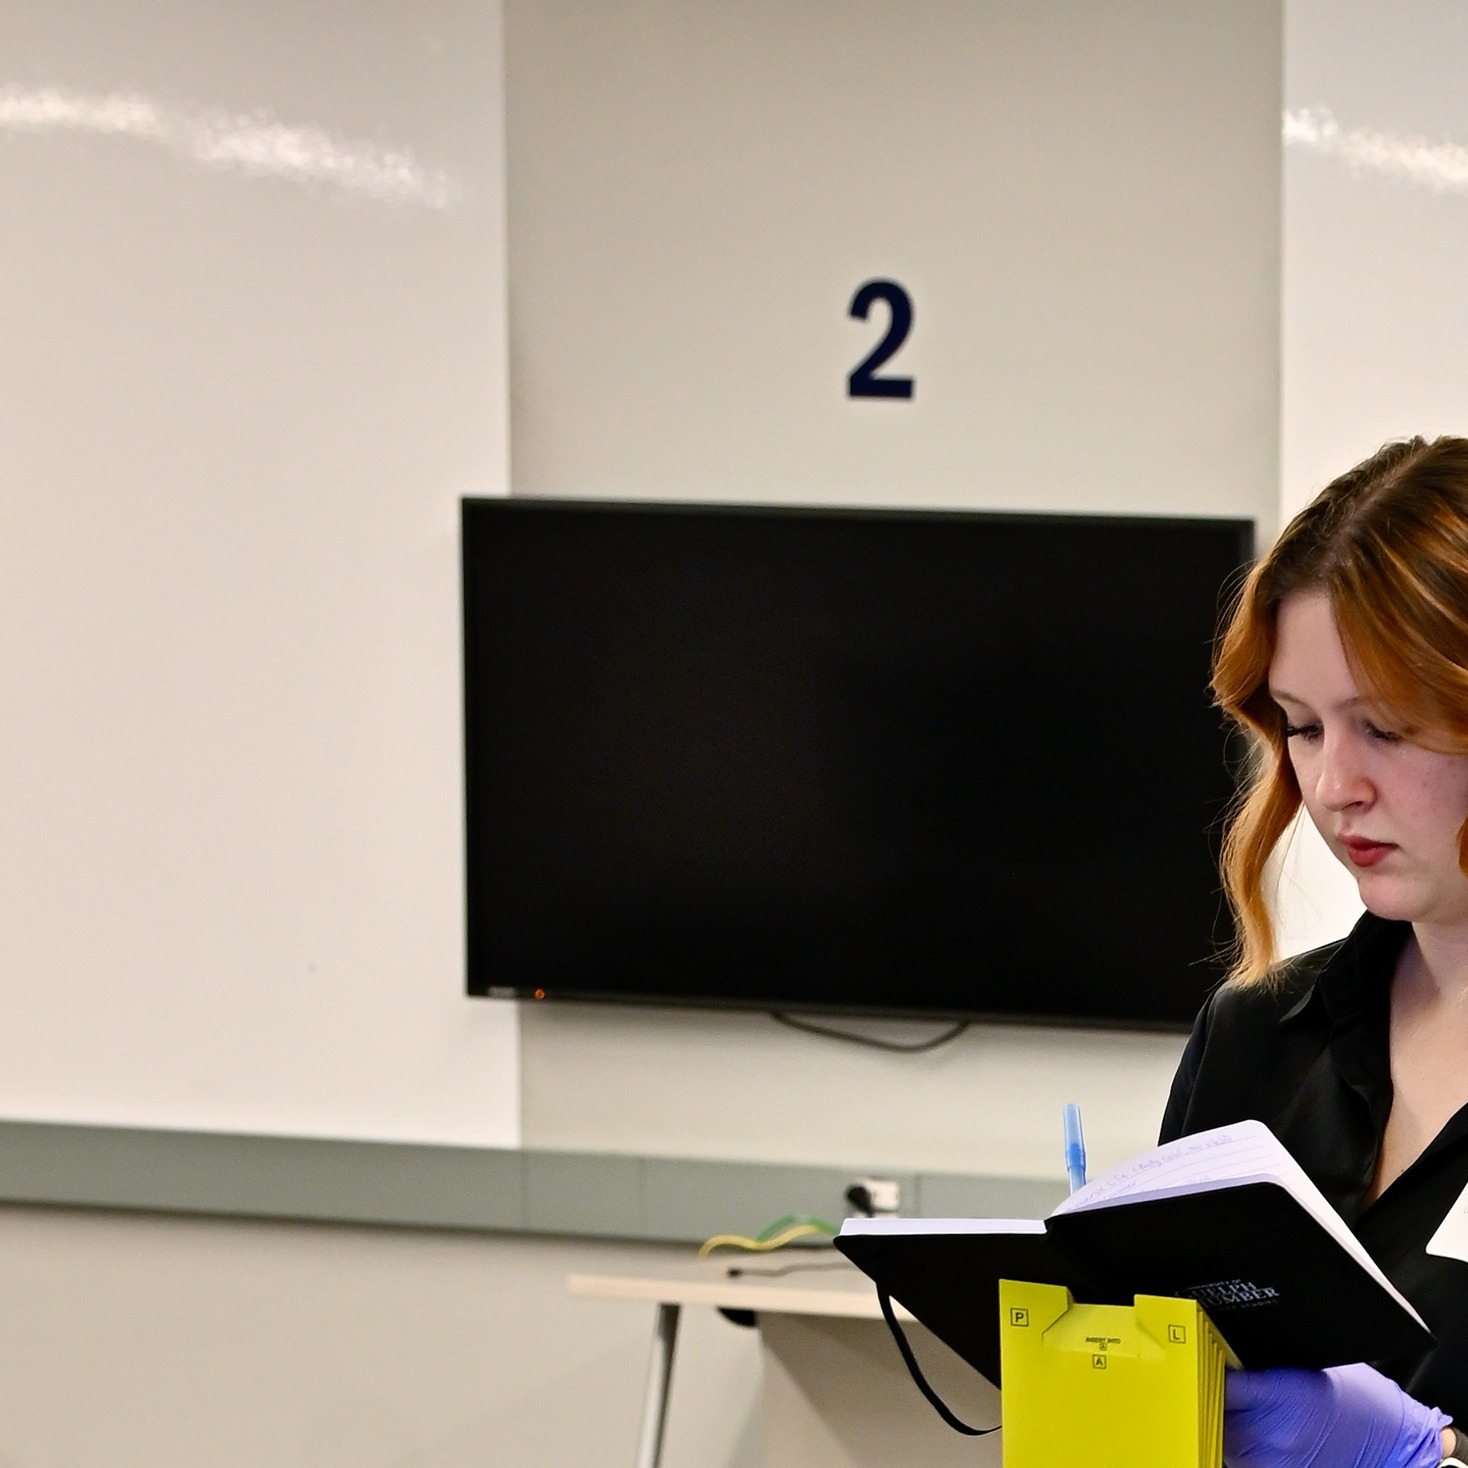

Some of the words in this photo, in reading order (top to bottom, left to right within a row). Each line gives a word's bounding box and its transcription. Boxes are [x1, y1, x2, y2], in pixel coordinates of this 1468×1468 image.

[848, 278, 914, 398] 2
[1015, 1311, 1025, 1323] P
[1172, 1329, 1181, 1340] L
